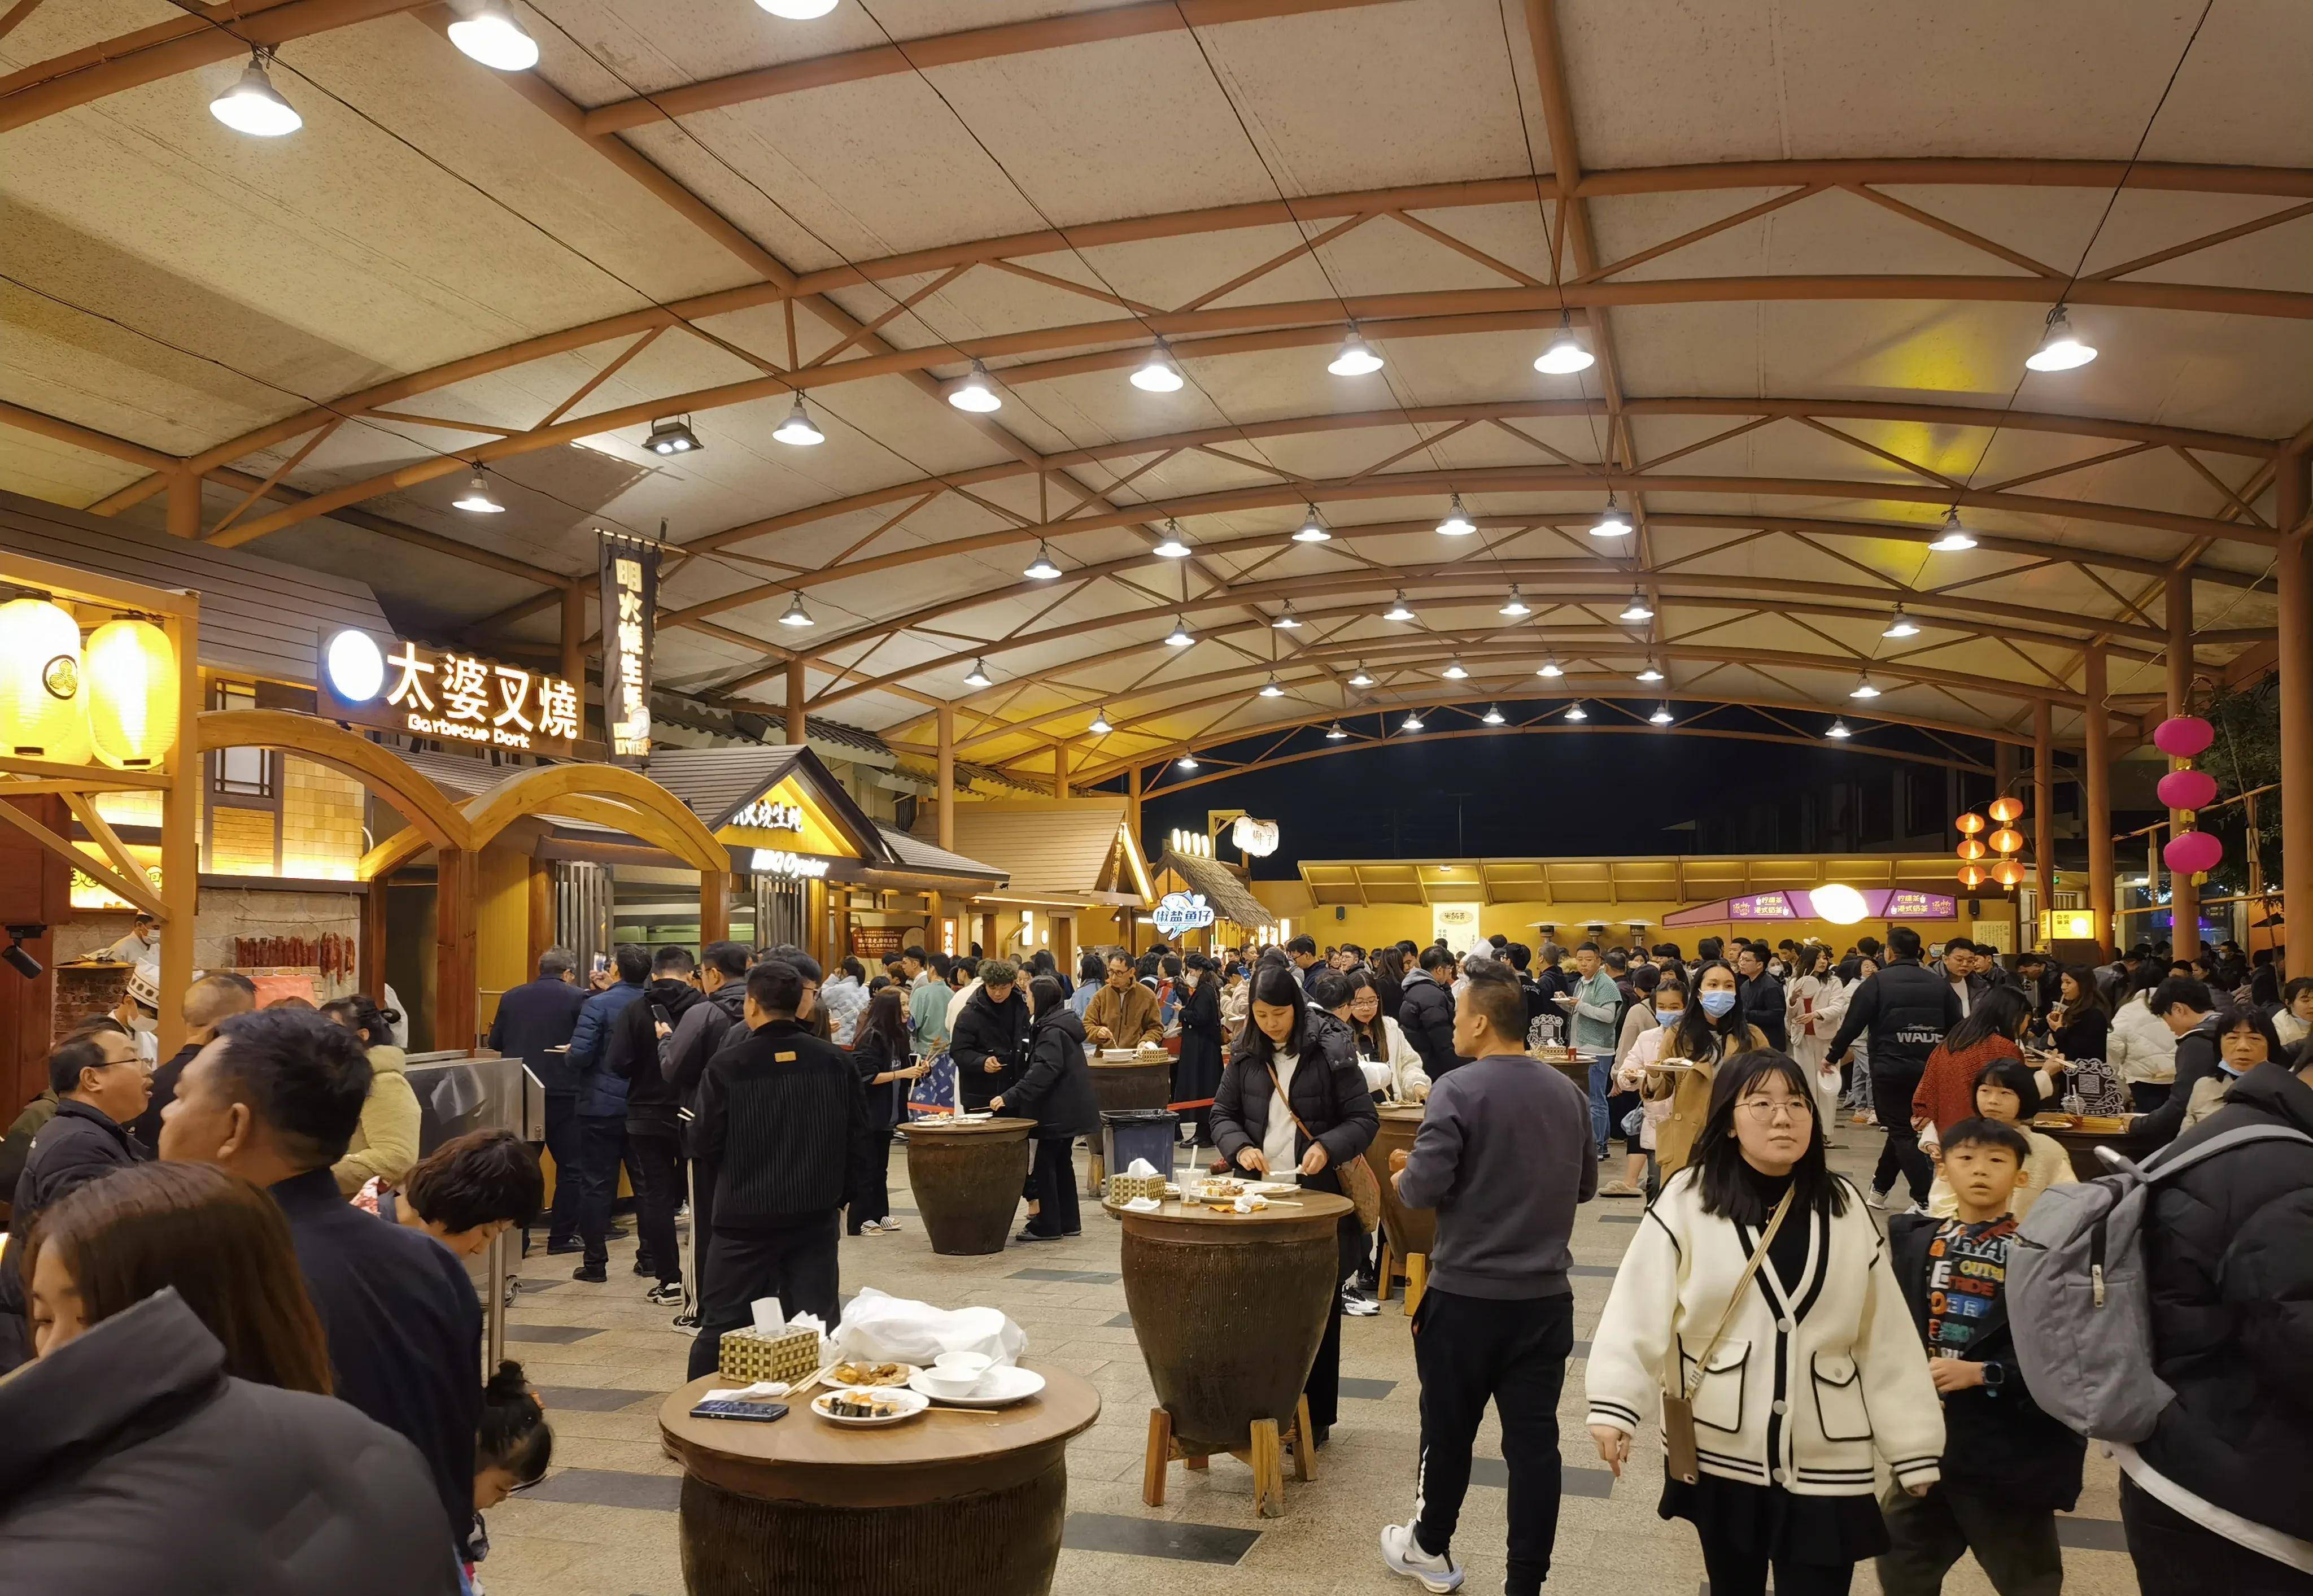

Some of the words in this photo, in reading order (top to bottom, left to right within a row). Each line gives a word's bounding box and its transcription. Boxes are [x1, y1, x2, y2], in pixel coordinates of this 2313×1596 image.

[387, 642, 577, 739] 太婆叉燒
[1156, 910, 1211, 922] 椒盐鱼仔
